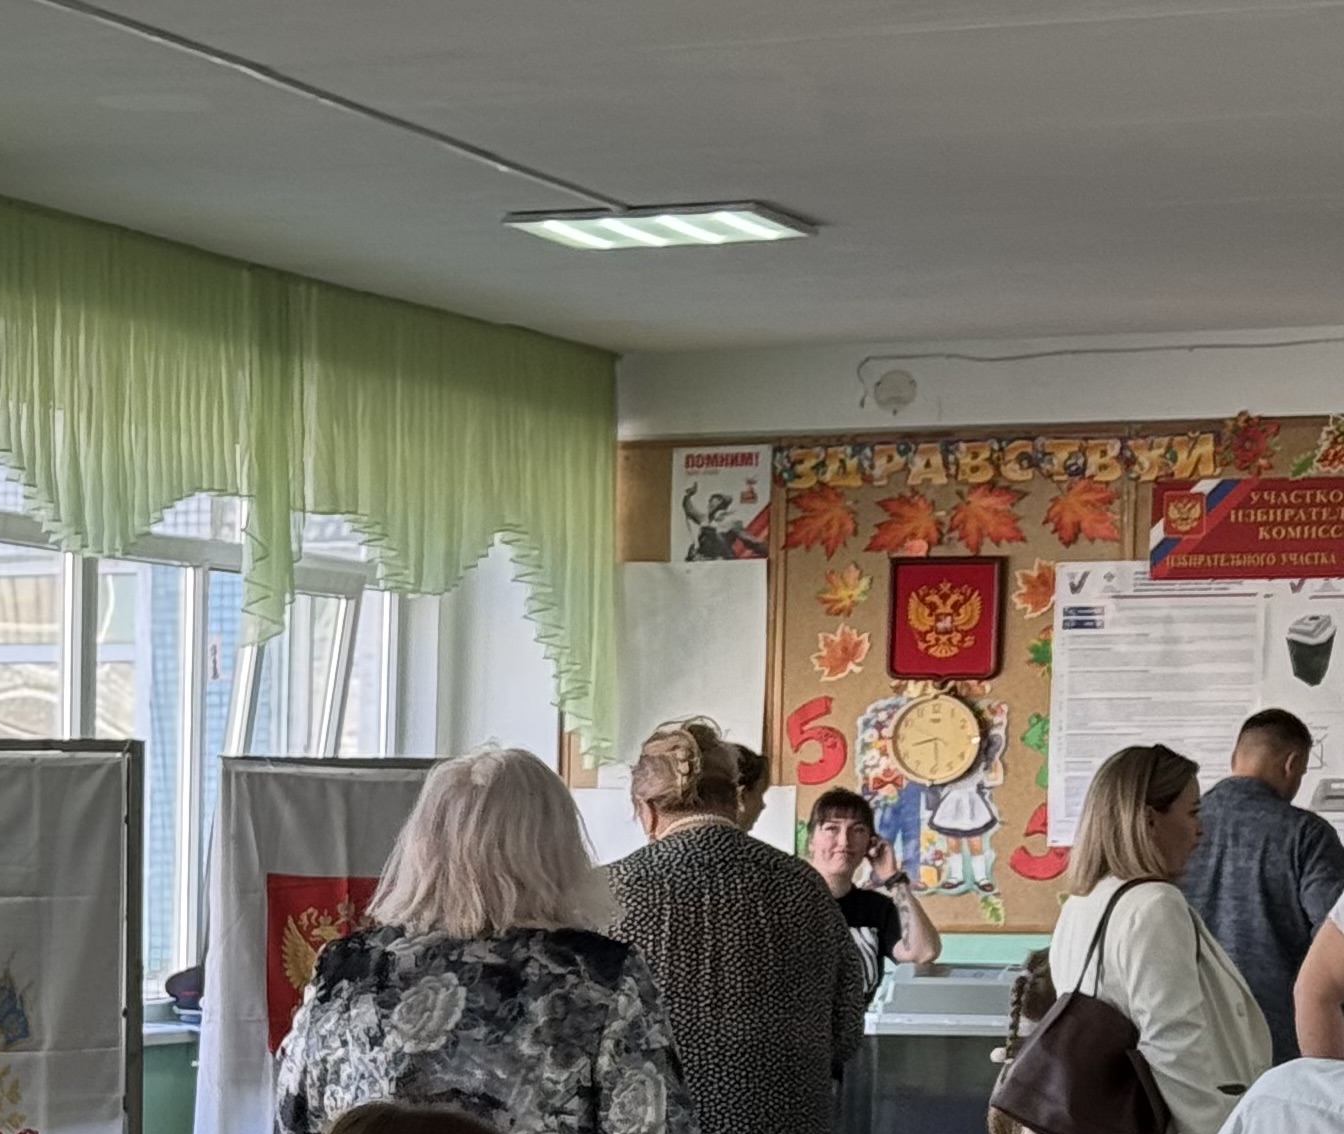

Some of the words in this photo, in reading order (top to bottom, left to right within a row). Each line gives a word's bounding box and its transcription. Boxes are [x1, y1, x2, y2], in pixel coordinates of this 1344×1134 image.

[685, 452, 759, 469] ПОМНИМ!
[787, 433, 1218, 489] ЗДРАВСТВУЙ
[1259, 525, 1343, 540] КОМИСС
[787, 696, 848, 785] 5
